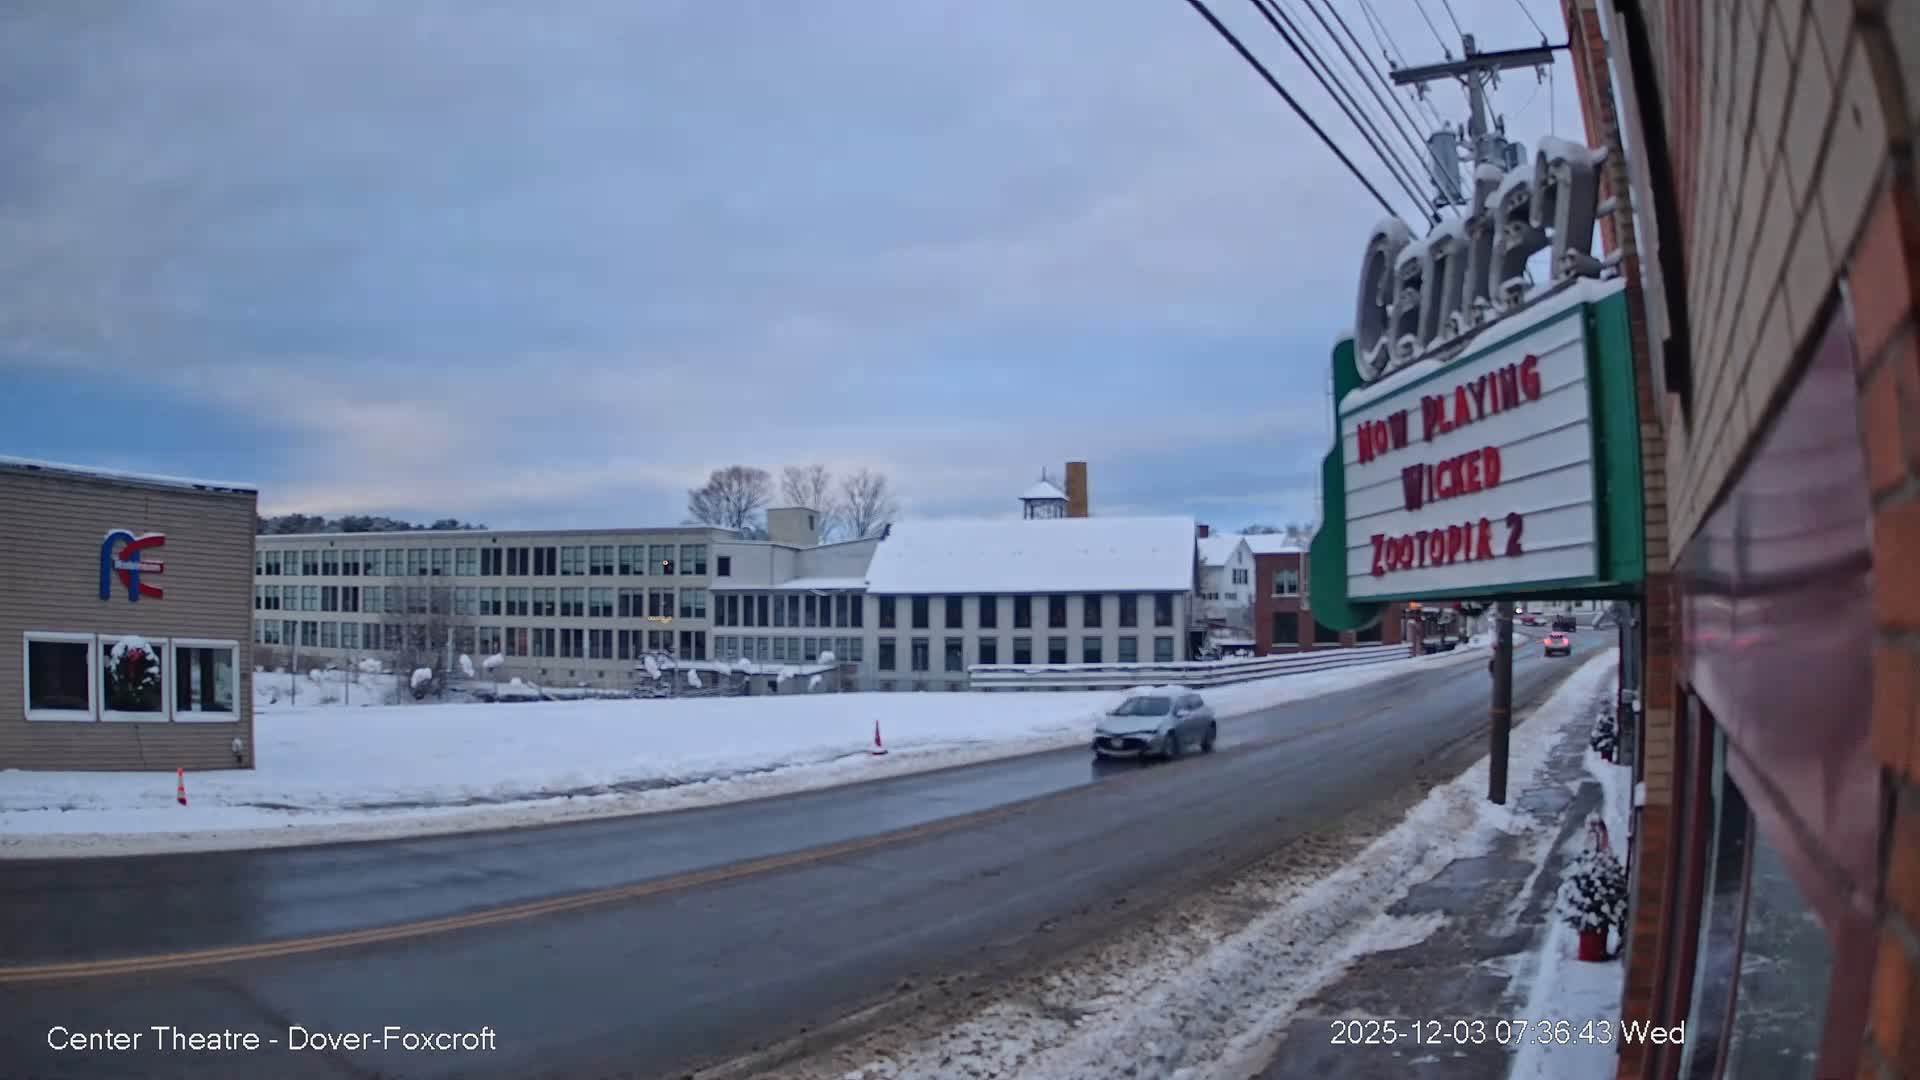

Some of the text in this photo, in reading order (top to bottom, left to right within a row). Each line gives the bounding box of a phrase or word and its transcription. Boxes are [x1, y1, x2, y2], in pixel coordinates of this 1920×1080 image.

[1357, 355, 1541, 464] NOW PLAYING
[1402, 446, 1501, 511] WICKED
[1371, 512, 1523, 577] ZOOTOPIA 2
